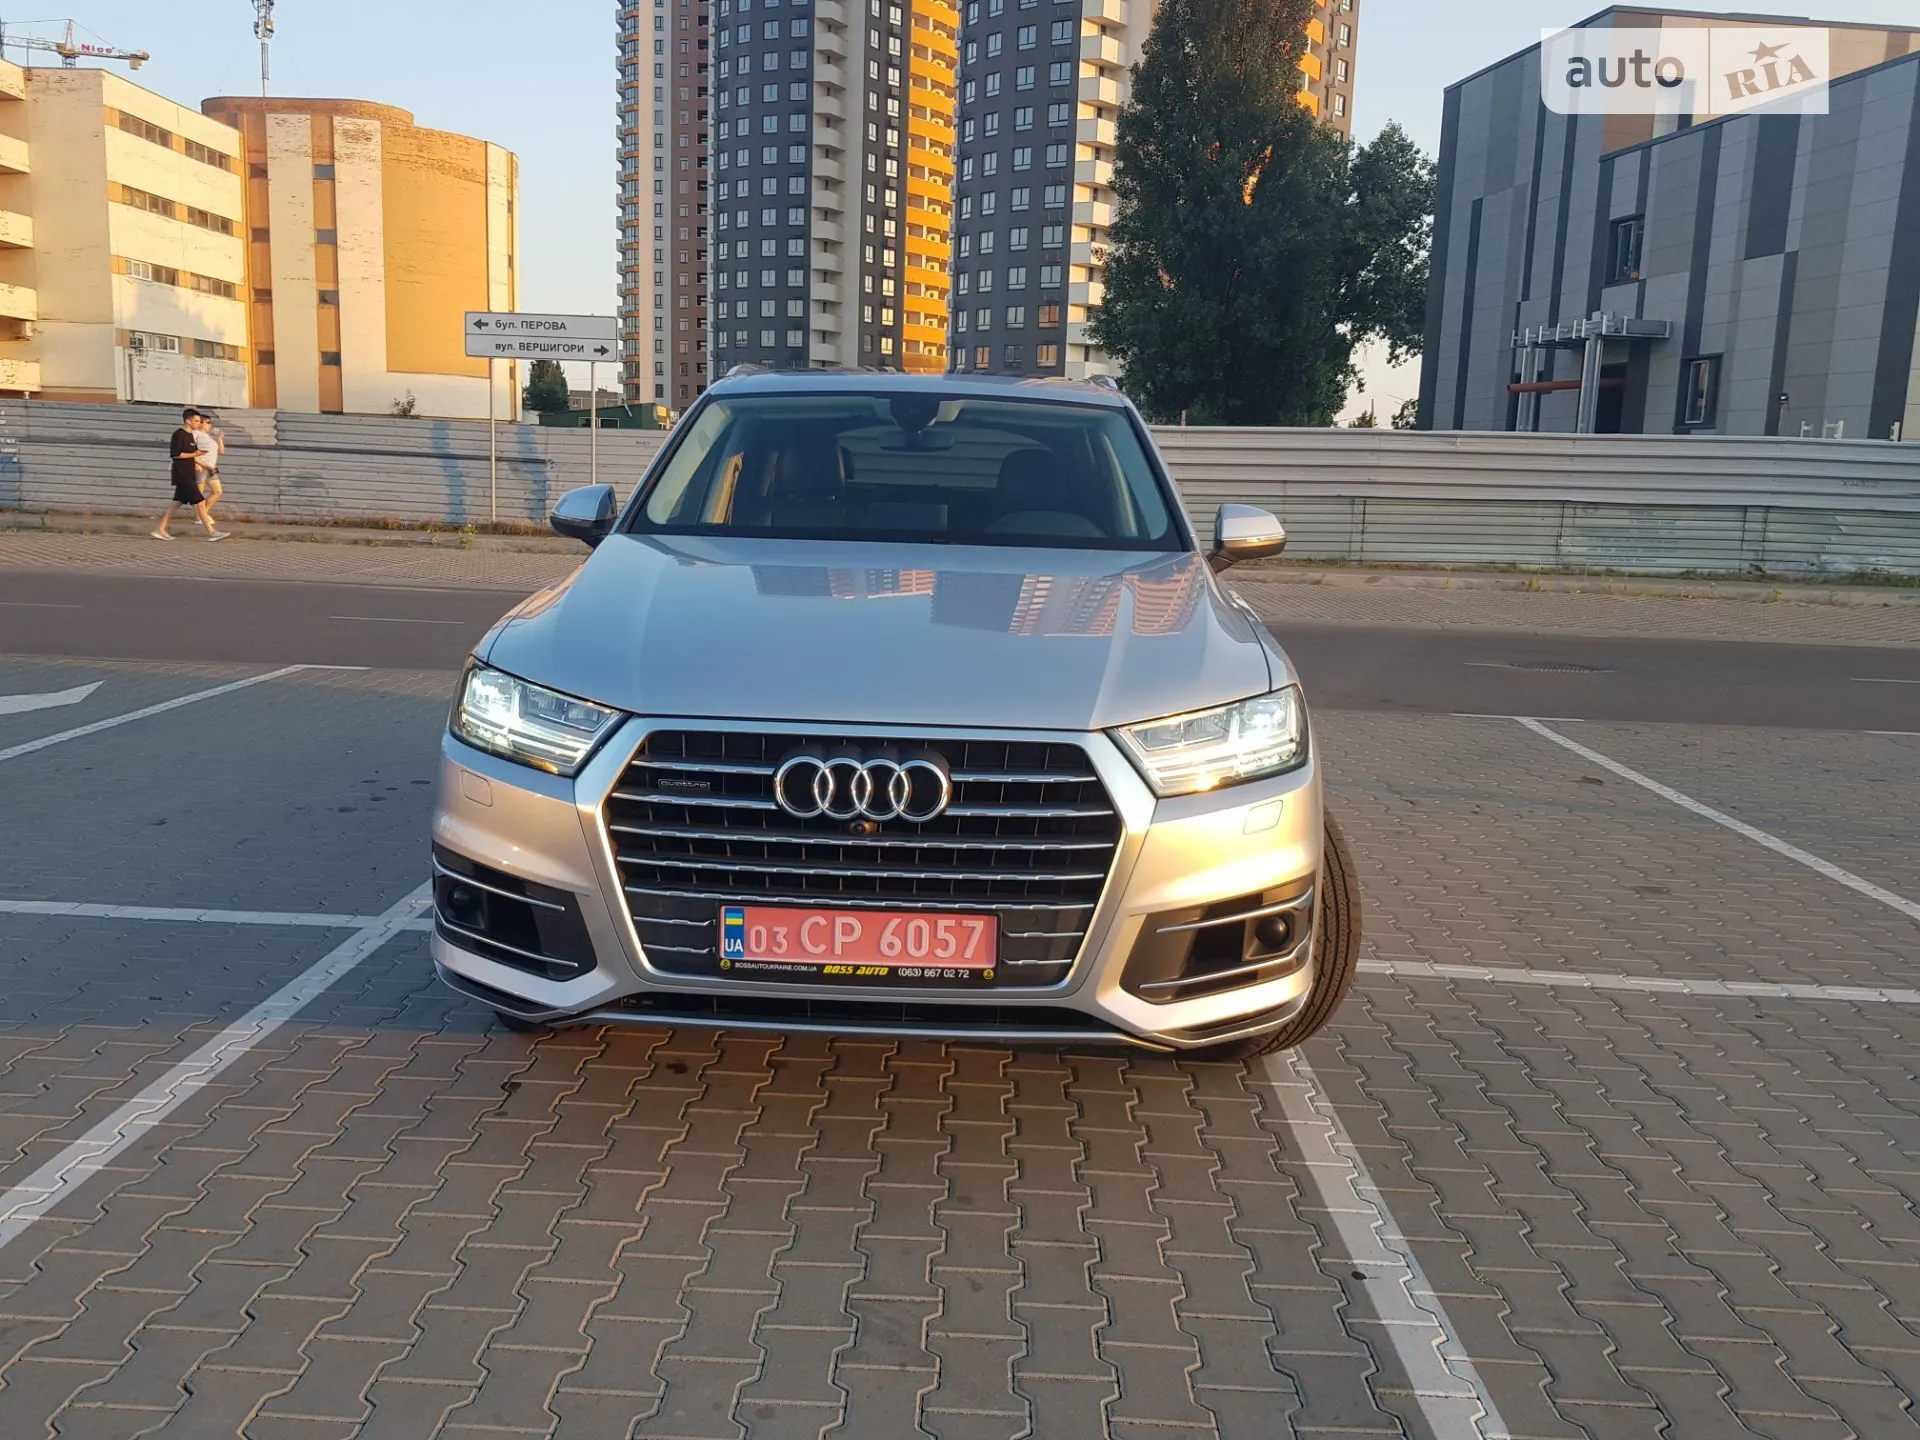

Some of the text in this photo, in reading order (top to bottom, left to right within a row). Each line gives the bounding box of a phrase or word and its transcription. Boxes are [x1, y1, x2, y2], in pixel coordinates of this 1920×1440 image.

[495, 320, 567, 331] бул. ПЕРОВА
[495, 342, 585, 353] вул. ВЕРШИГОРИ
[749, 915, 985, 959] 03 CP 6057
[725, 938, 744, 952] UA
[734, 962, 970, 979] BOSSAUTOUKRAINE.COM.UA BOSS AUTO (063) 667 02 72
